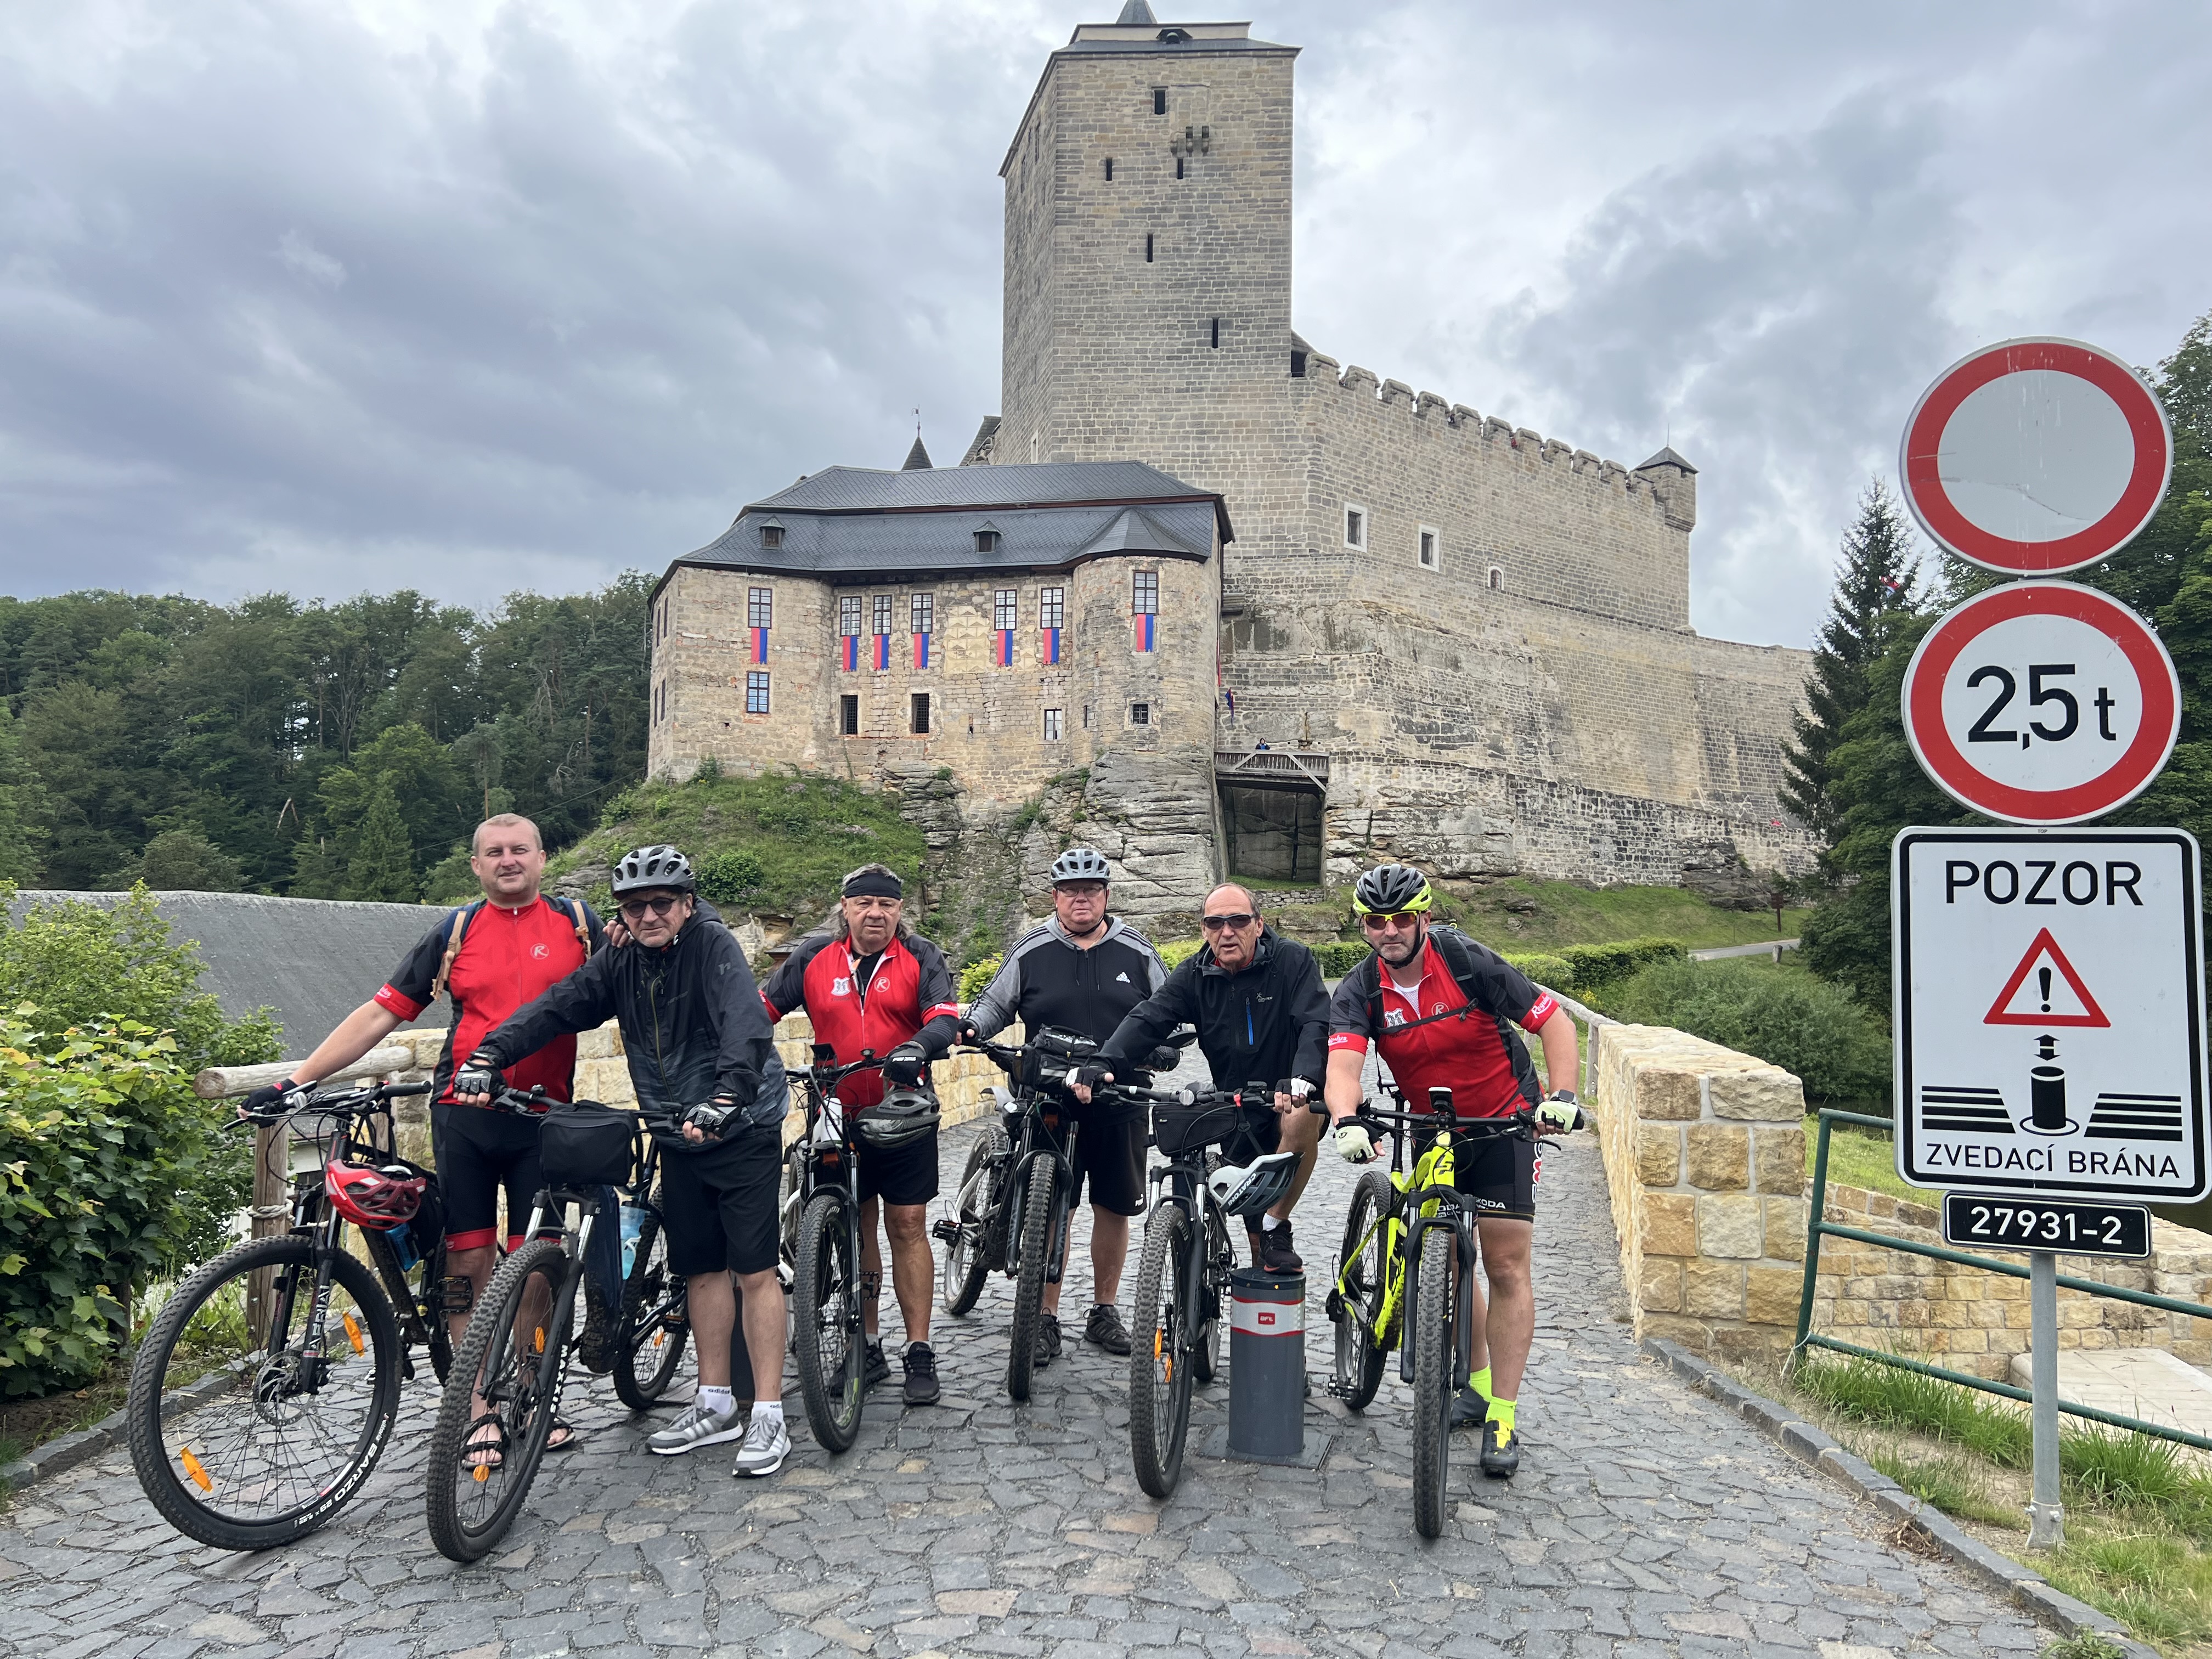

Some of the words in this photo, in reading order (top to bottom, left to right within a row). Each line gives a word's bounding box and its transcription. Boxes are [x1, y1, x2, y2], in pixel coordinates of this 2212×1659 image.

[1967, 664, 2079, 751] 2,5
[2094, 687, 2117, 741] t
[1945, 860, 2143, 906] POZOR
[1926, 1143, 2055, 1172] ZVEDACÍ
[2068, 1147, 2180, 1179] BRÁNA
[1228, 1173, 1256, 1206] CRATONI
[1476, 1199, 1506, 1209] KODA
[1971, 1206, 2123, 1245] 27931-2
[550, 1344, 568, 1413] MAXXIS
[335, 1443, 378, 1502] BARZO
